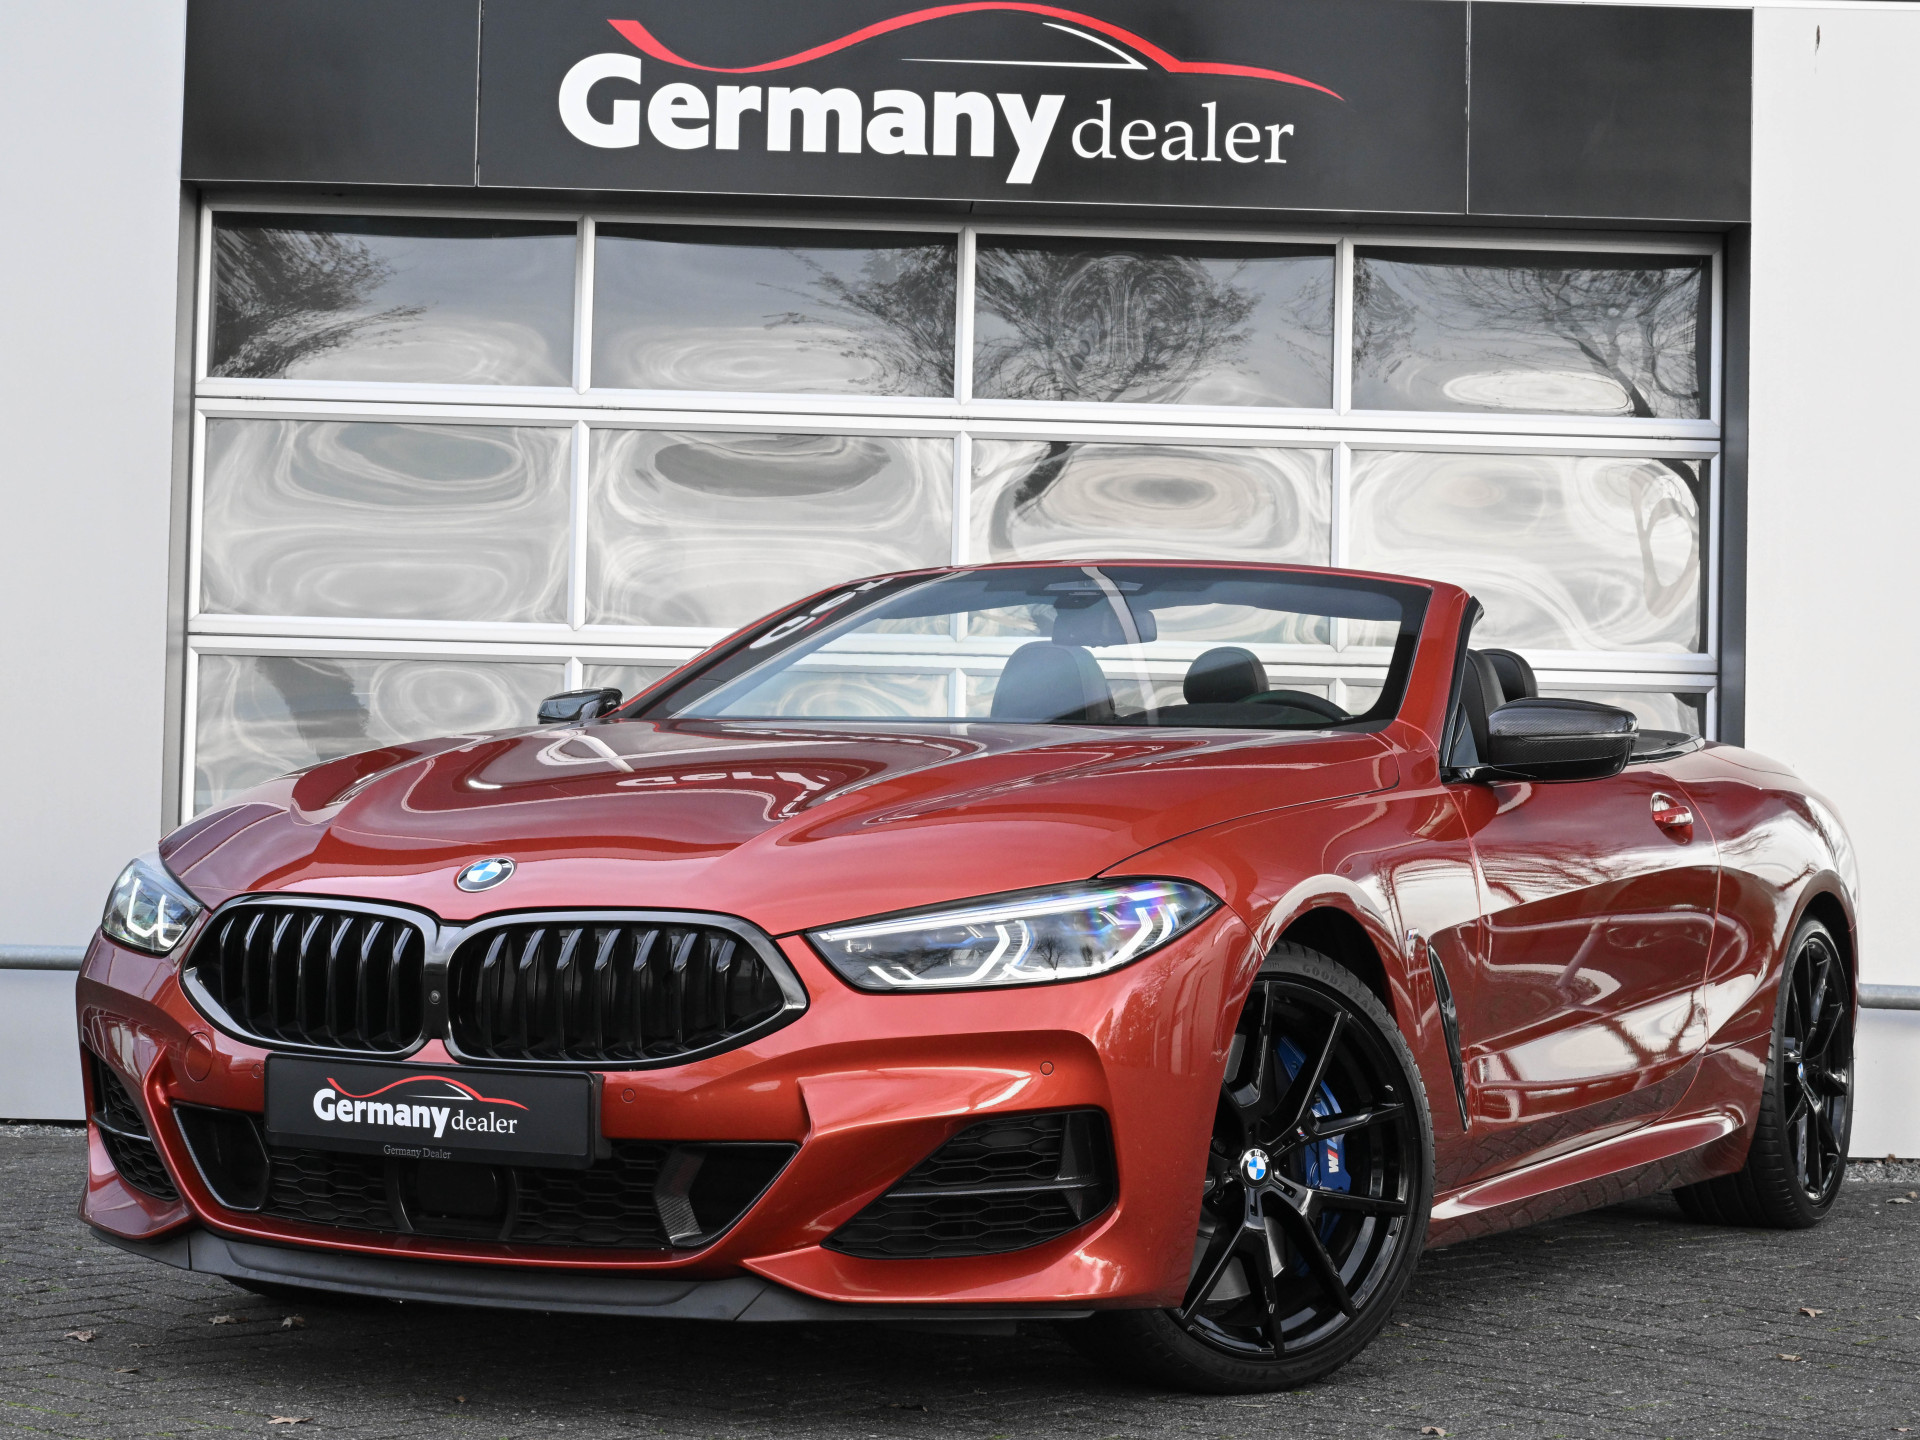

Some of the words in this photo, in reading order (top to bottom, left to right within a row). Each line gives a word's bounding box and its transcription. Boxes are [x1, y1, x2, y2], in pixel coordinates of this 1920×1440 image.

[558, 52, 1066, 185] Germany
[1071, 98, 1295, 165] dealer
[312, 1087, 451, 1139] Germany
[451, 1109, 518, 1134] dealer
[383, 1144, 422, 1159] Germany
[422, 1147, 452, 1160] Dealer
